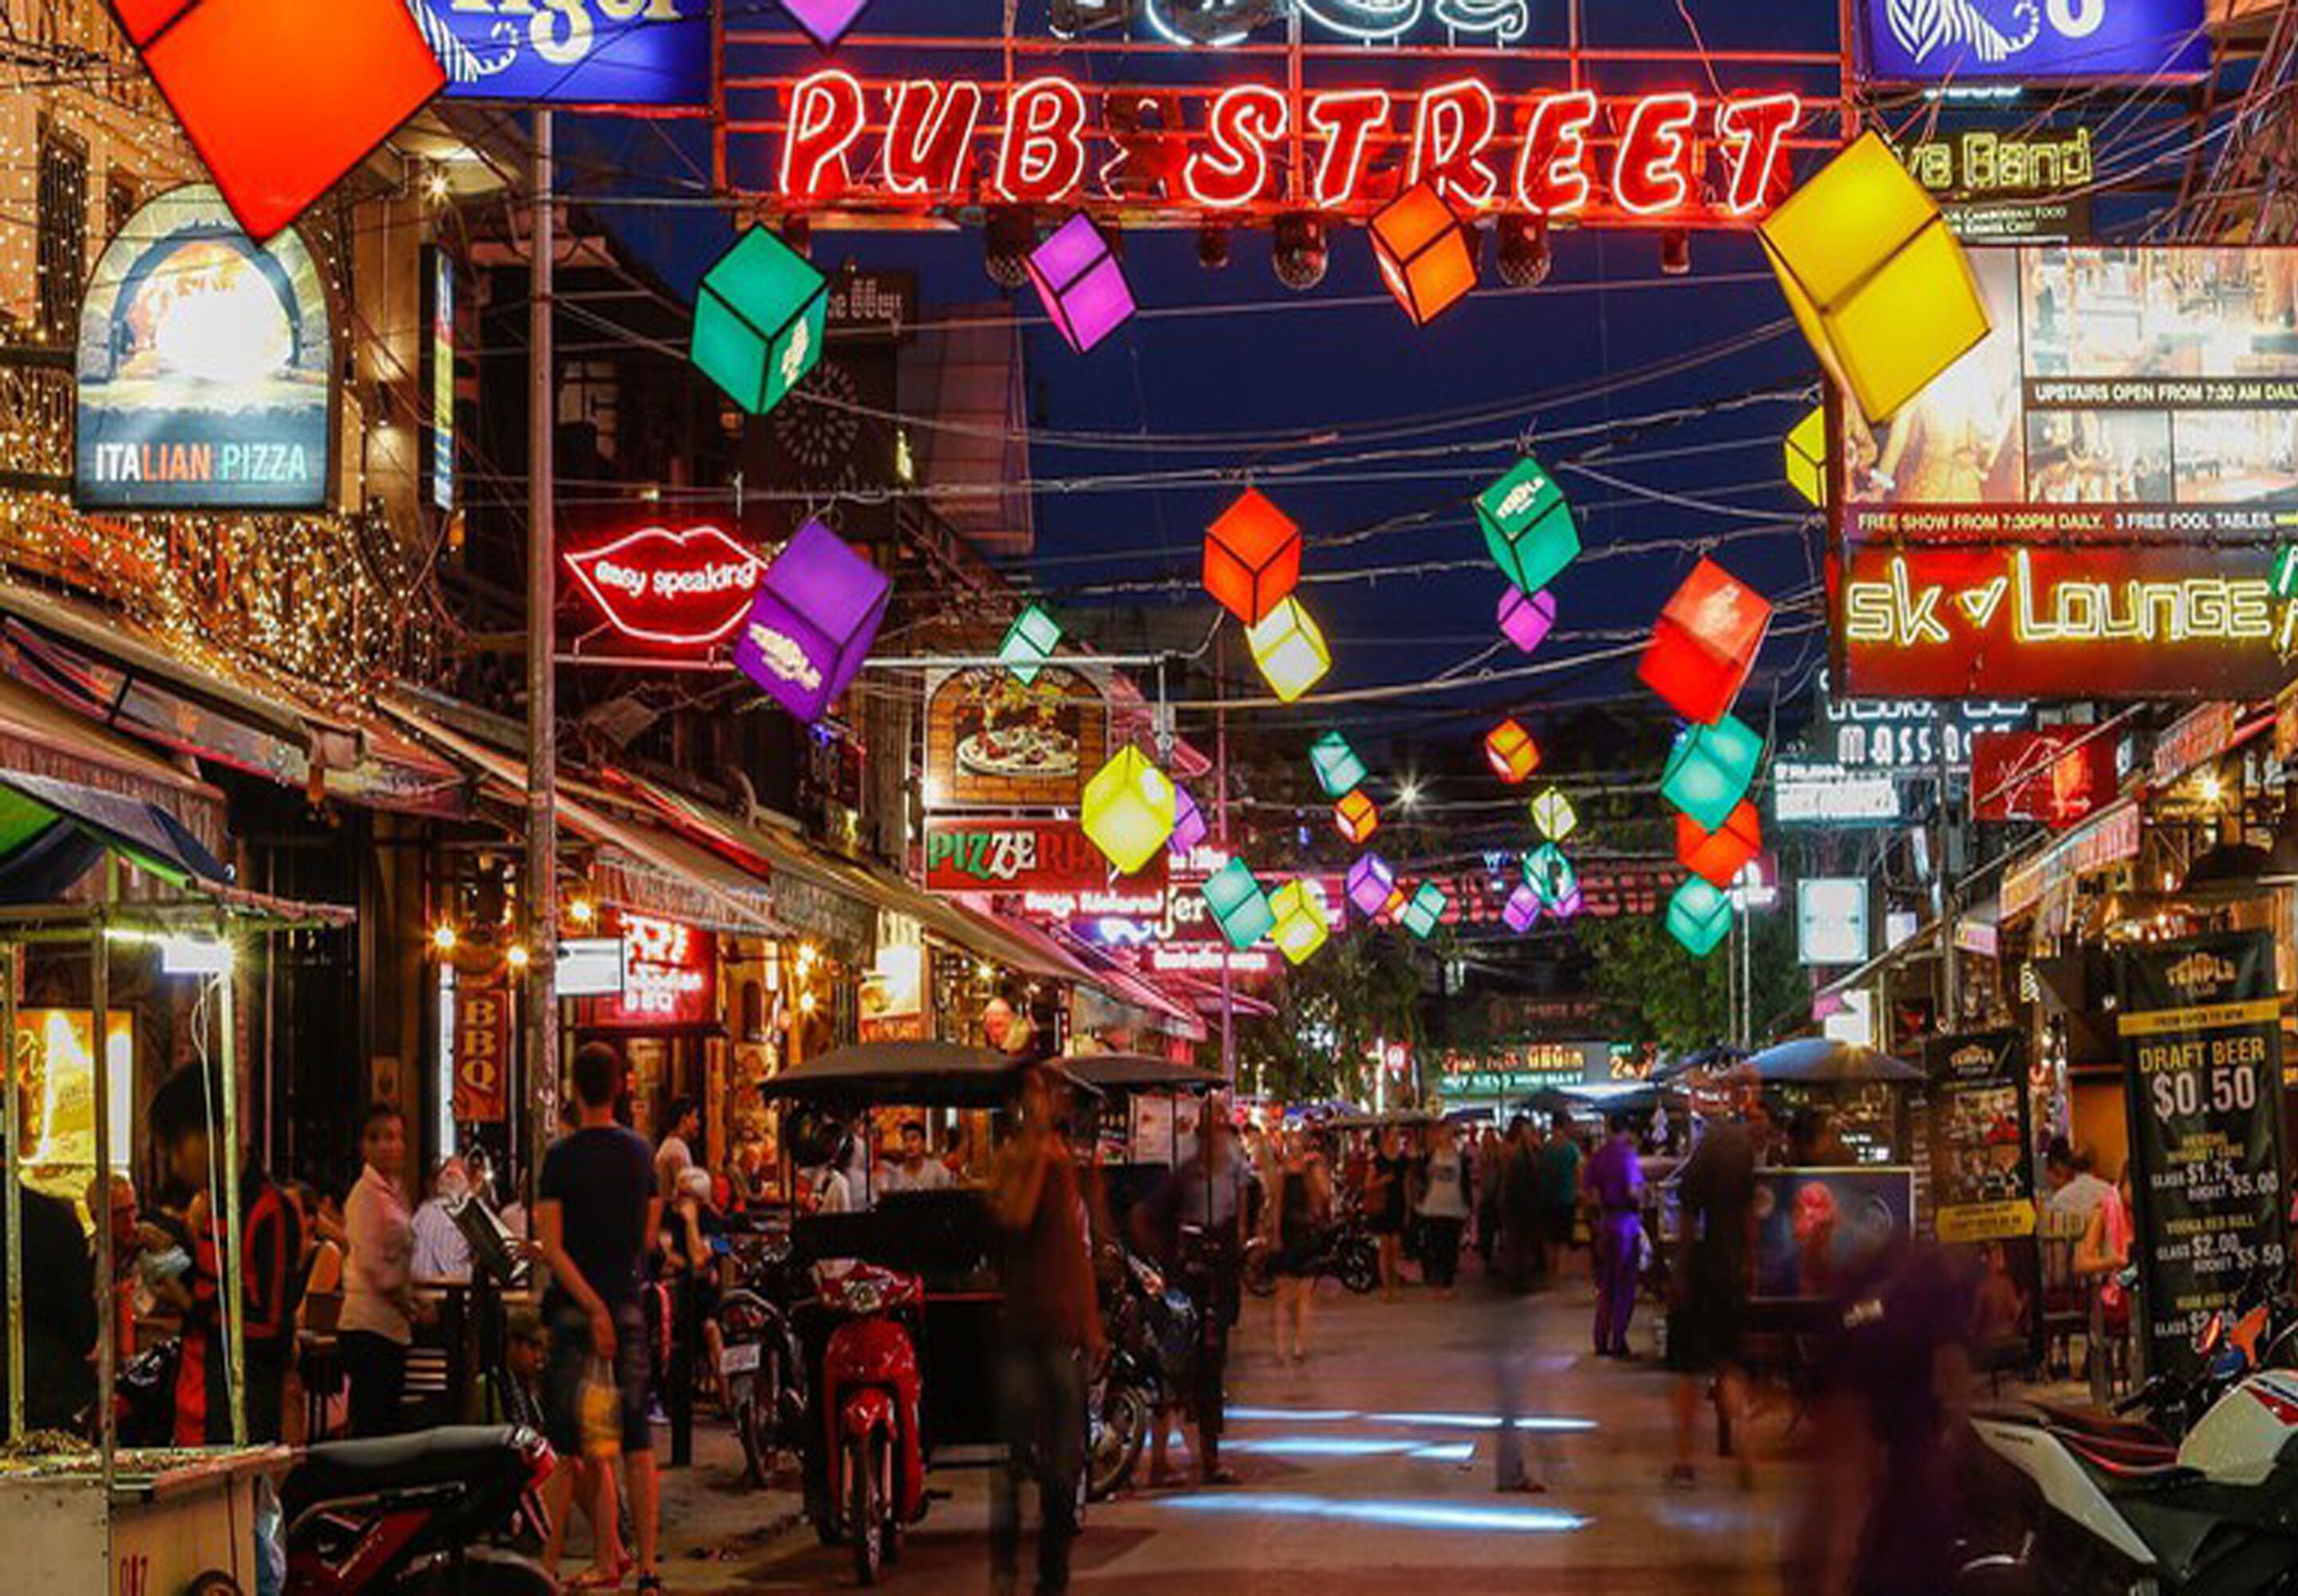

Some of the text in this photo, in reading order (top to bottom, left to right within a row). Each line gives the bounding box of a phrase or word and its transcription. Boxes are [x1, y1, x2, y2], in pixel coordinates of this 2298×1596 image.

[780, 69, 1799, 215] PUB STREET
[2035, 383, 2108, 401] UPSTAIRS
[2113, 383, 2154, 401] OPEN
[2158, 383, 2202, 400] FROM
[2237, 384, 2262, 399] AM
[95, 442, 308, 483] ITALIAN PIZZA
[1858, 514, 1897, 530] FREE
[1901, 514, 1949, 531] SHOW
[1953, 514, 1999, 531] FROM
[2127, 512, 2166, 529] FREE
[2170, 512, 2213, 529] POOL
[595, 560, 756, 599] easy speaking
[462, 1001, 496, 1093] BBQ
[2138, 1037, 2265, 1073] DRAFT BEER
[2153, 1066, 2256, 1123] $0.50
[2187, 1159, 2234, 1185] $1.75
[2231, 1171, 2279, 1197] $5.00
[2192, 1233, 2240, 1257] $2.00
